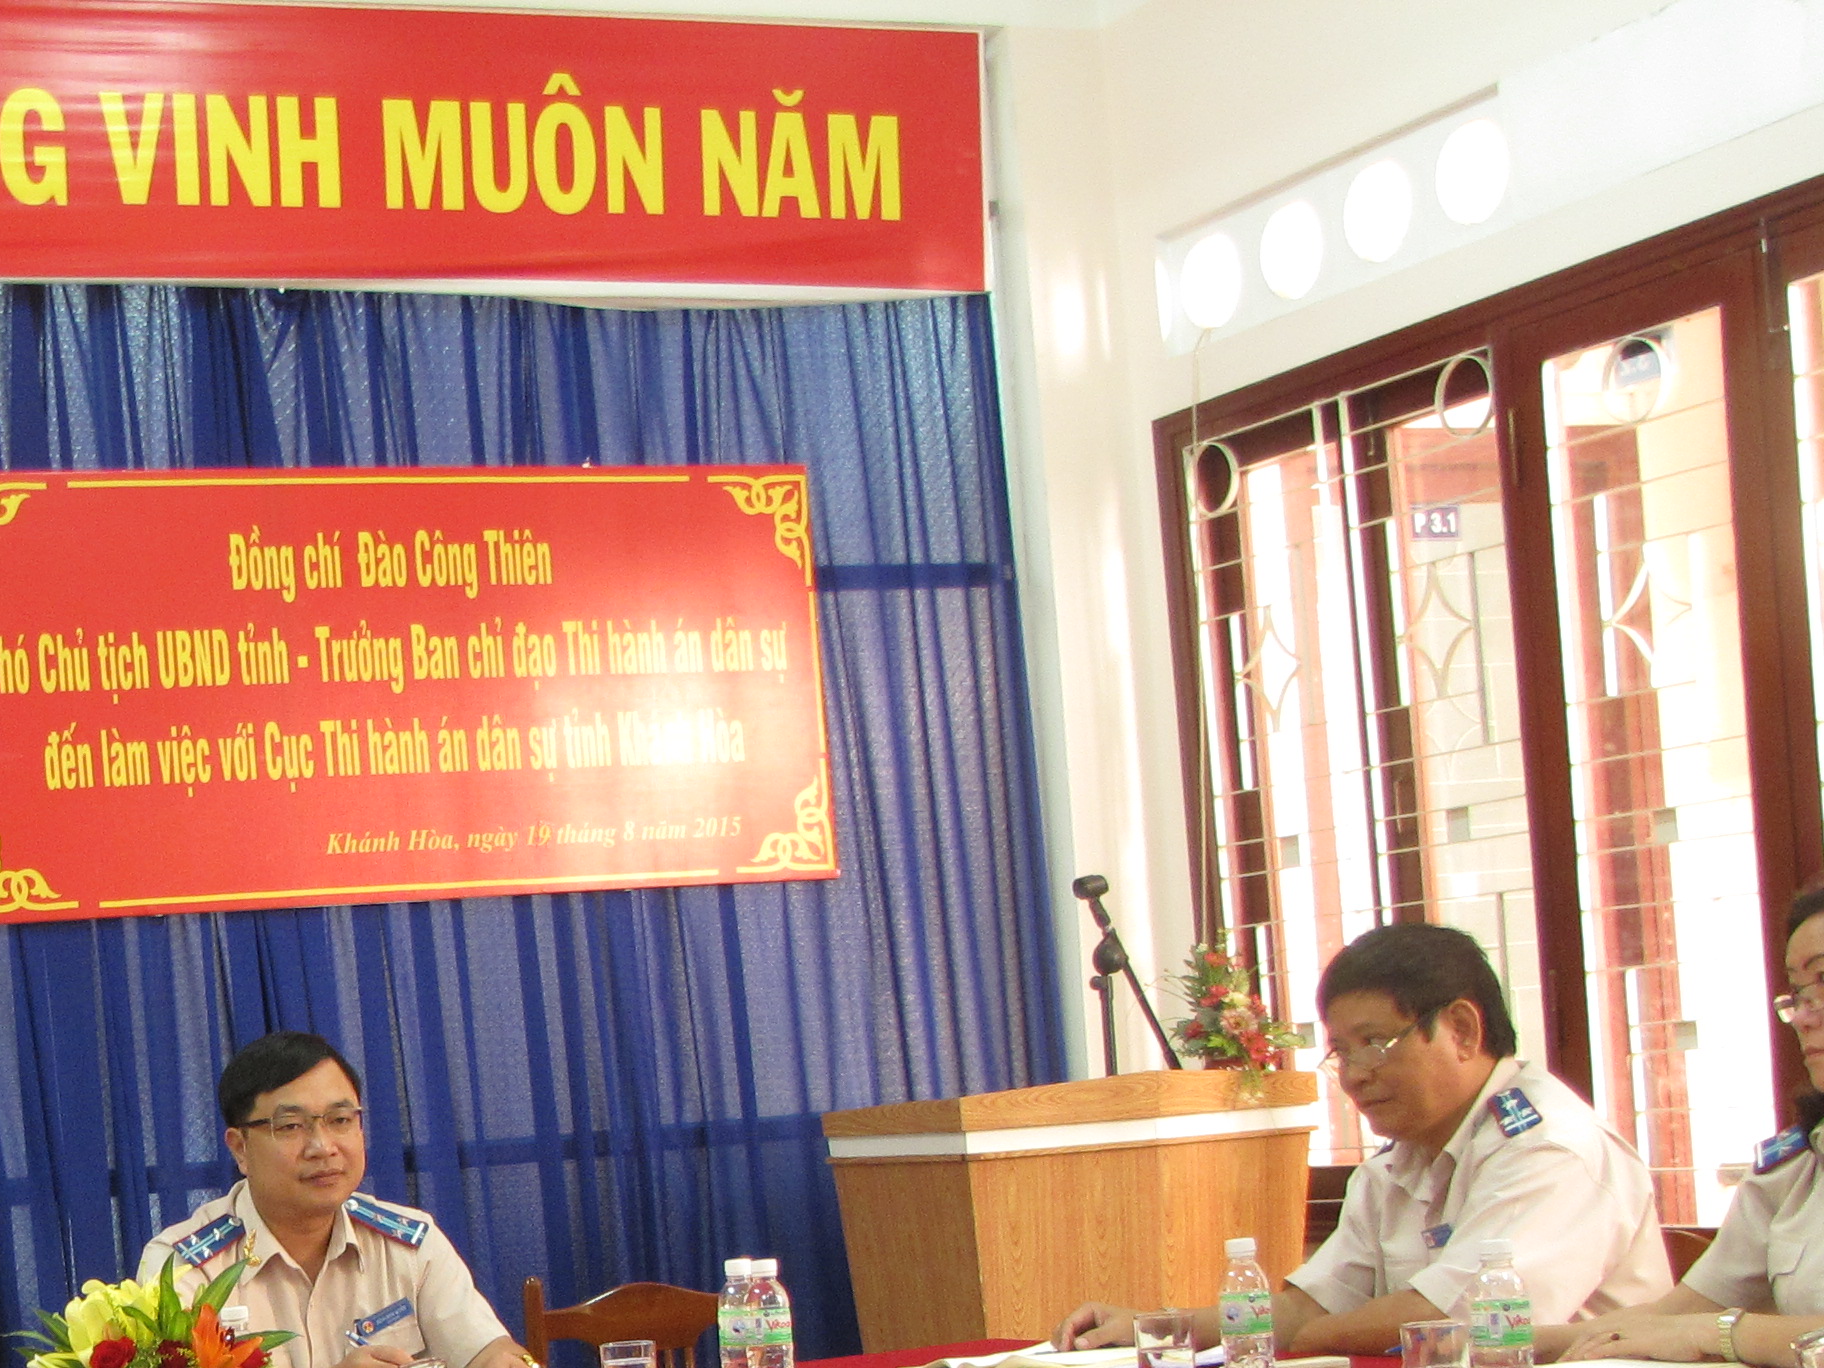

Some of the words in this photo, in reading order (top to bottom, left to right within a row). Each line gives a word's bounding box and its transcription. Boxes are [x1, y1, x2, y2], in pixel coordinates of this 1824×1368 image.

[98, 90, 342, 211] VINH
[383, 72, 665, 216] MUÔN
[702, 87, 902, 222] NĂM
[229, 525, 297, 604] Đồng
[303, 530, 343, 590] chí
[357, 529, 407, 588] Đào
[414, 529, 479, 600] Công
[483, 529, 553, 586] Thiên
[1430, 511, 1457, 534] 3.1
[38, 627, 91, 694] Chủ
[97, 631, 151, 705] tịch
[156, 629, 232, 690] UBND
[238, 622, 291, 686] tỉnh
[313, 619, 405, 694] Trưởng
[410, 623, 461, 681] Ban
[467, 617, 506, 679] chỉ
[512, 621, 557, 691] đạo
[562, 619, 601, 676] Thi
[607, 619, 668, 675] hành
[673, 617, 704, 674] án
[710, 616, 754, 673] dân
[760, 620, 788, 684] sự
[44, 722, 95, 791] đến
[100, 729, 152, 788] làm
[157, 724, 212, 798] việc
[218, 722, 258, 782] với
[264, 721, 315, 793] Cục
[320, 718, 362, 777] Thi
[367, 717, 431, 775] hành
[437, 715, 470, 773] án
[477, 713, 523, 772] dân
[528, 718, 558, 783] sự
[563, 706, 613, 769] tỉnh
[327, 830, 401, 855] Khánh
[407, 829, 461, 851] Hòa,
[466, 826, 519, 854] ngày
[526, 823, 553, 847] 19
[556, 822, 617, 849] tháng
[623, 820, 636, 842] 8
[641, 820, 687, 841] năm
[692, 816, 742, 839] 2015
